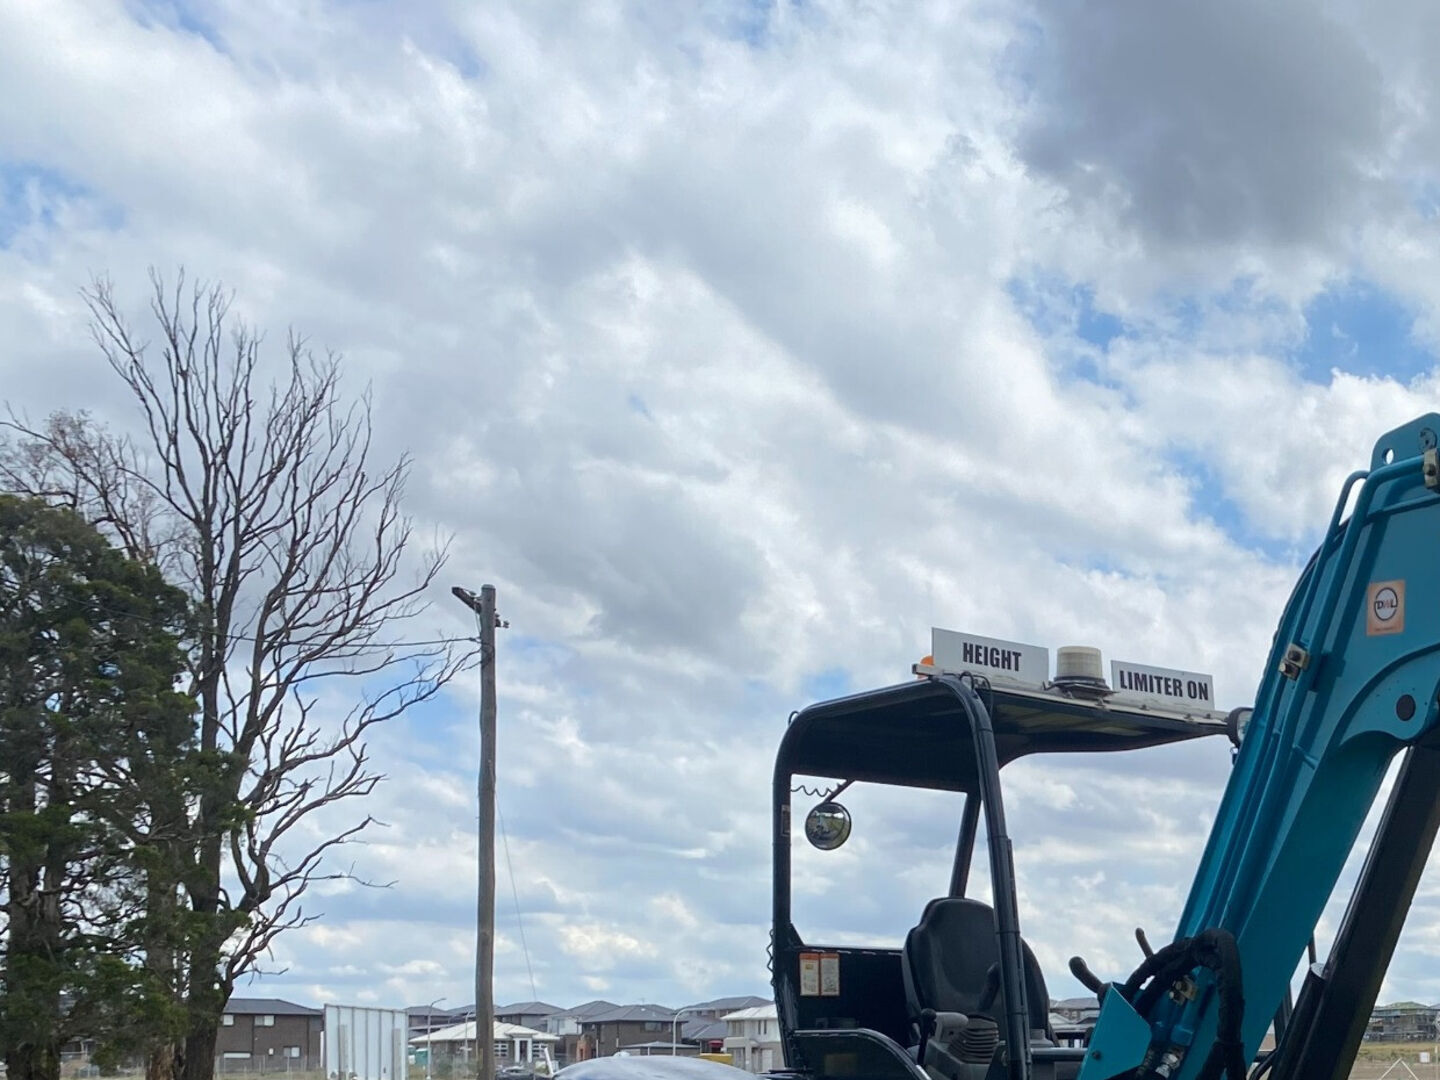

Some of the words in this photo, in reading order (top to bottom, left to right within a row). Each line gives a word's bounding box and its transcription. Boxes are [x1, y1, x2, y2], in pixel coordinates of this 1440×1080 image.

[962, 642, 1022, 672] HEIGHT
[1119, 670, 1183, 697] LIMITER
[1187, 680, 1209, 701] ON
